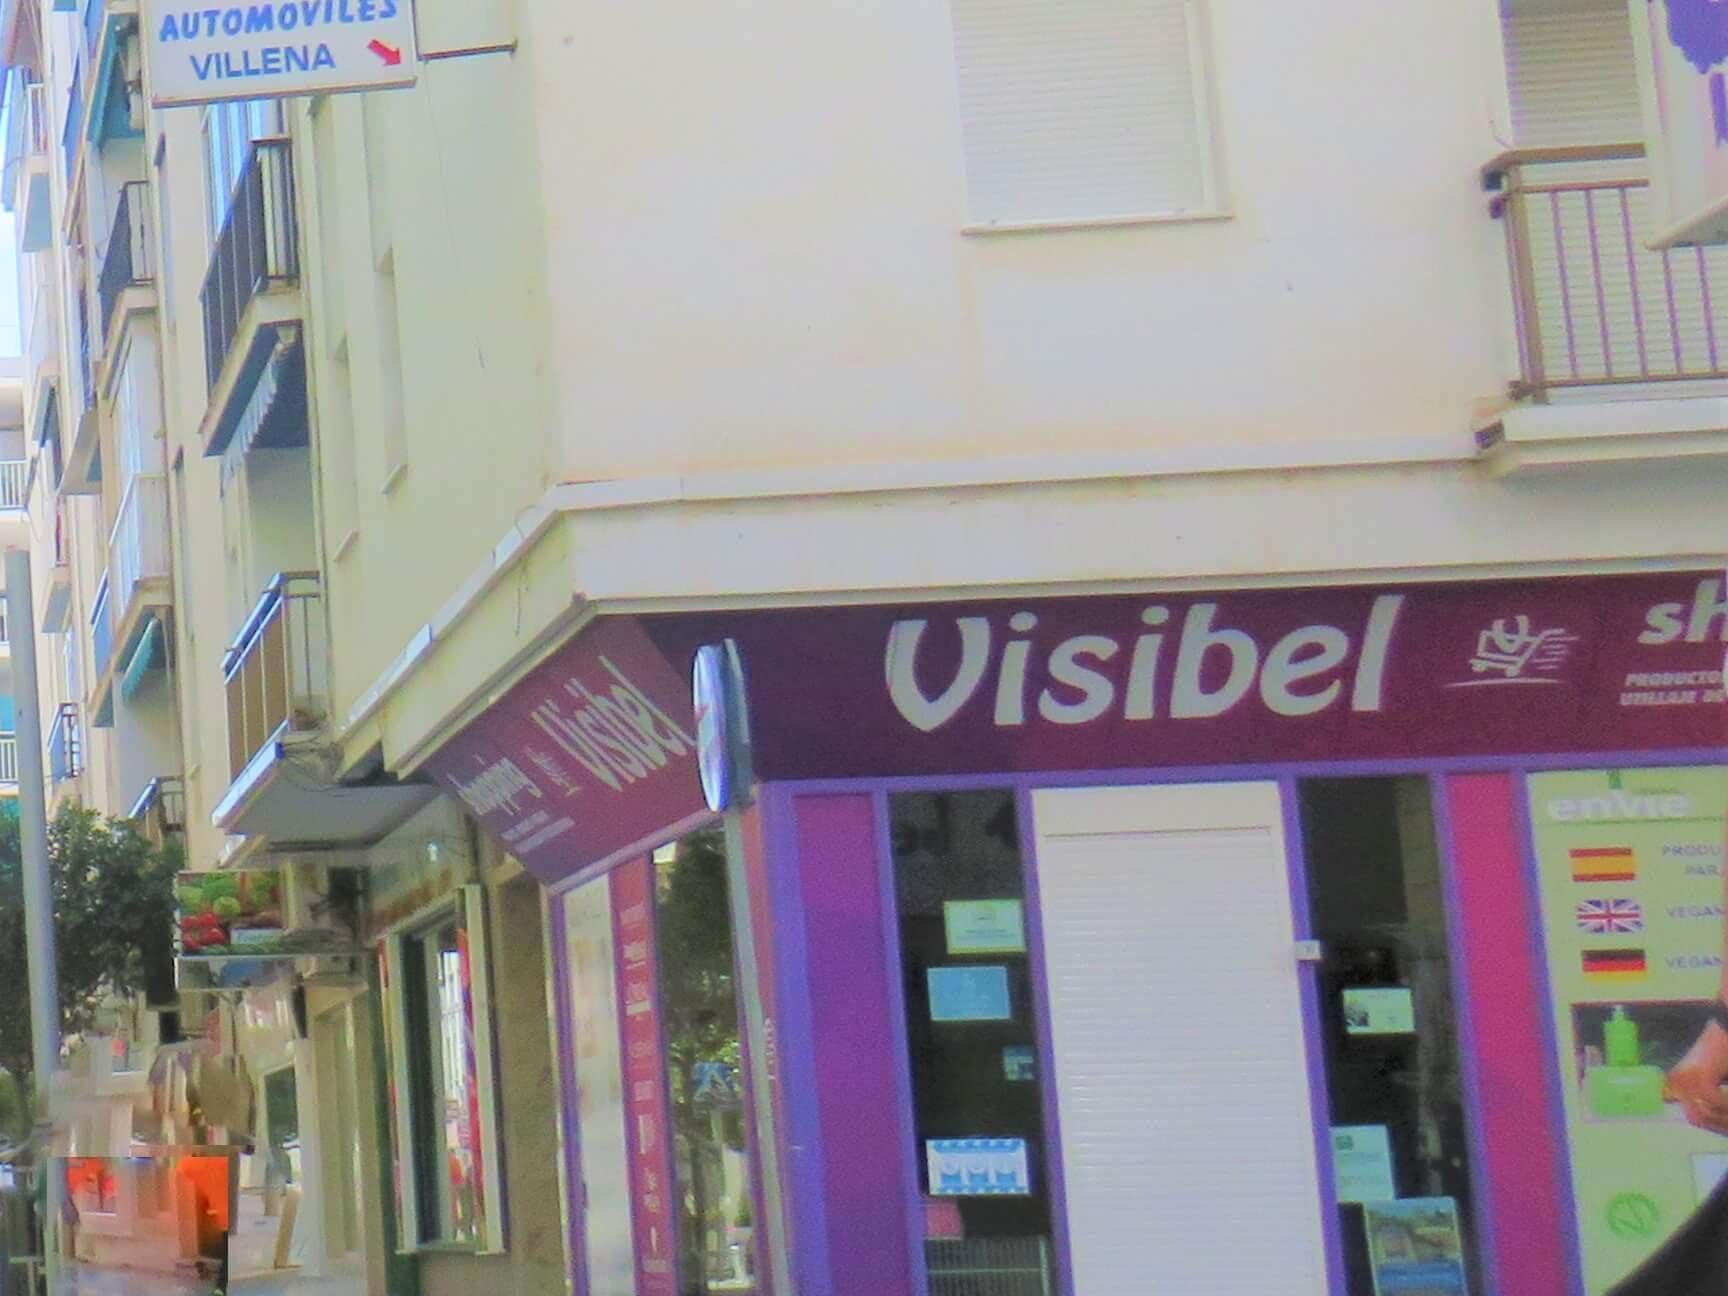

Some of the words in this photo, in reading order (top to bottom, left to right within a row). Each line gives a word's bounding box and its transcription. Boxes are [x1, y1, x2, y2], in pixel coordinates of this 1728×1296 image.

[189, 43, 337, 82] VILLENA
[529, 655, 697, 793] Visibel
[884, 594, 1406, 733] Visibel
